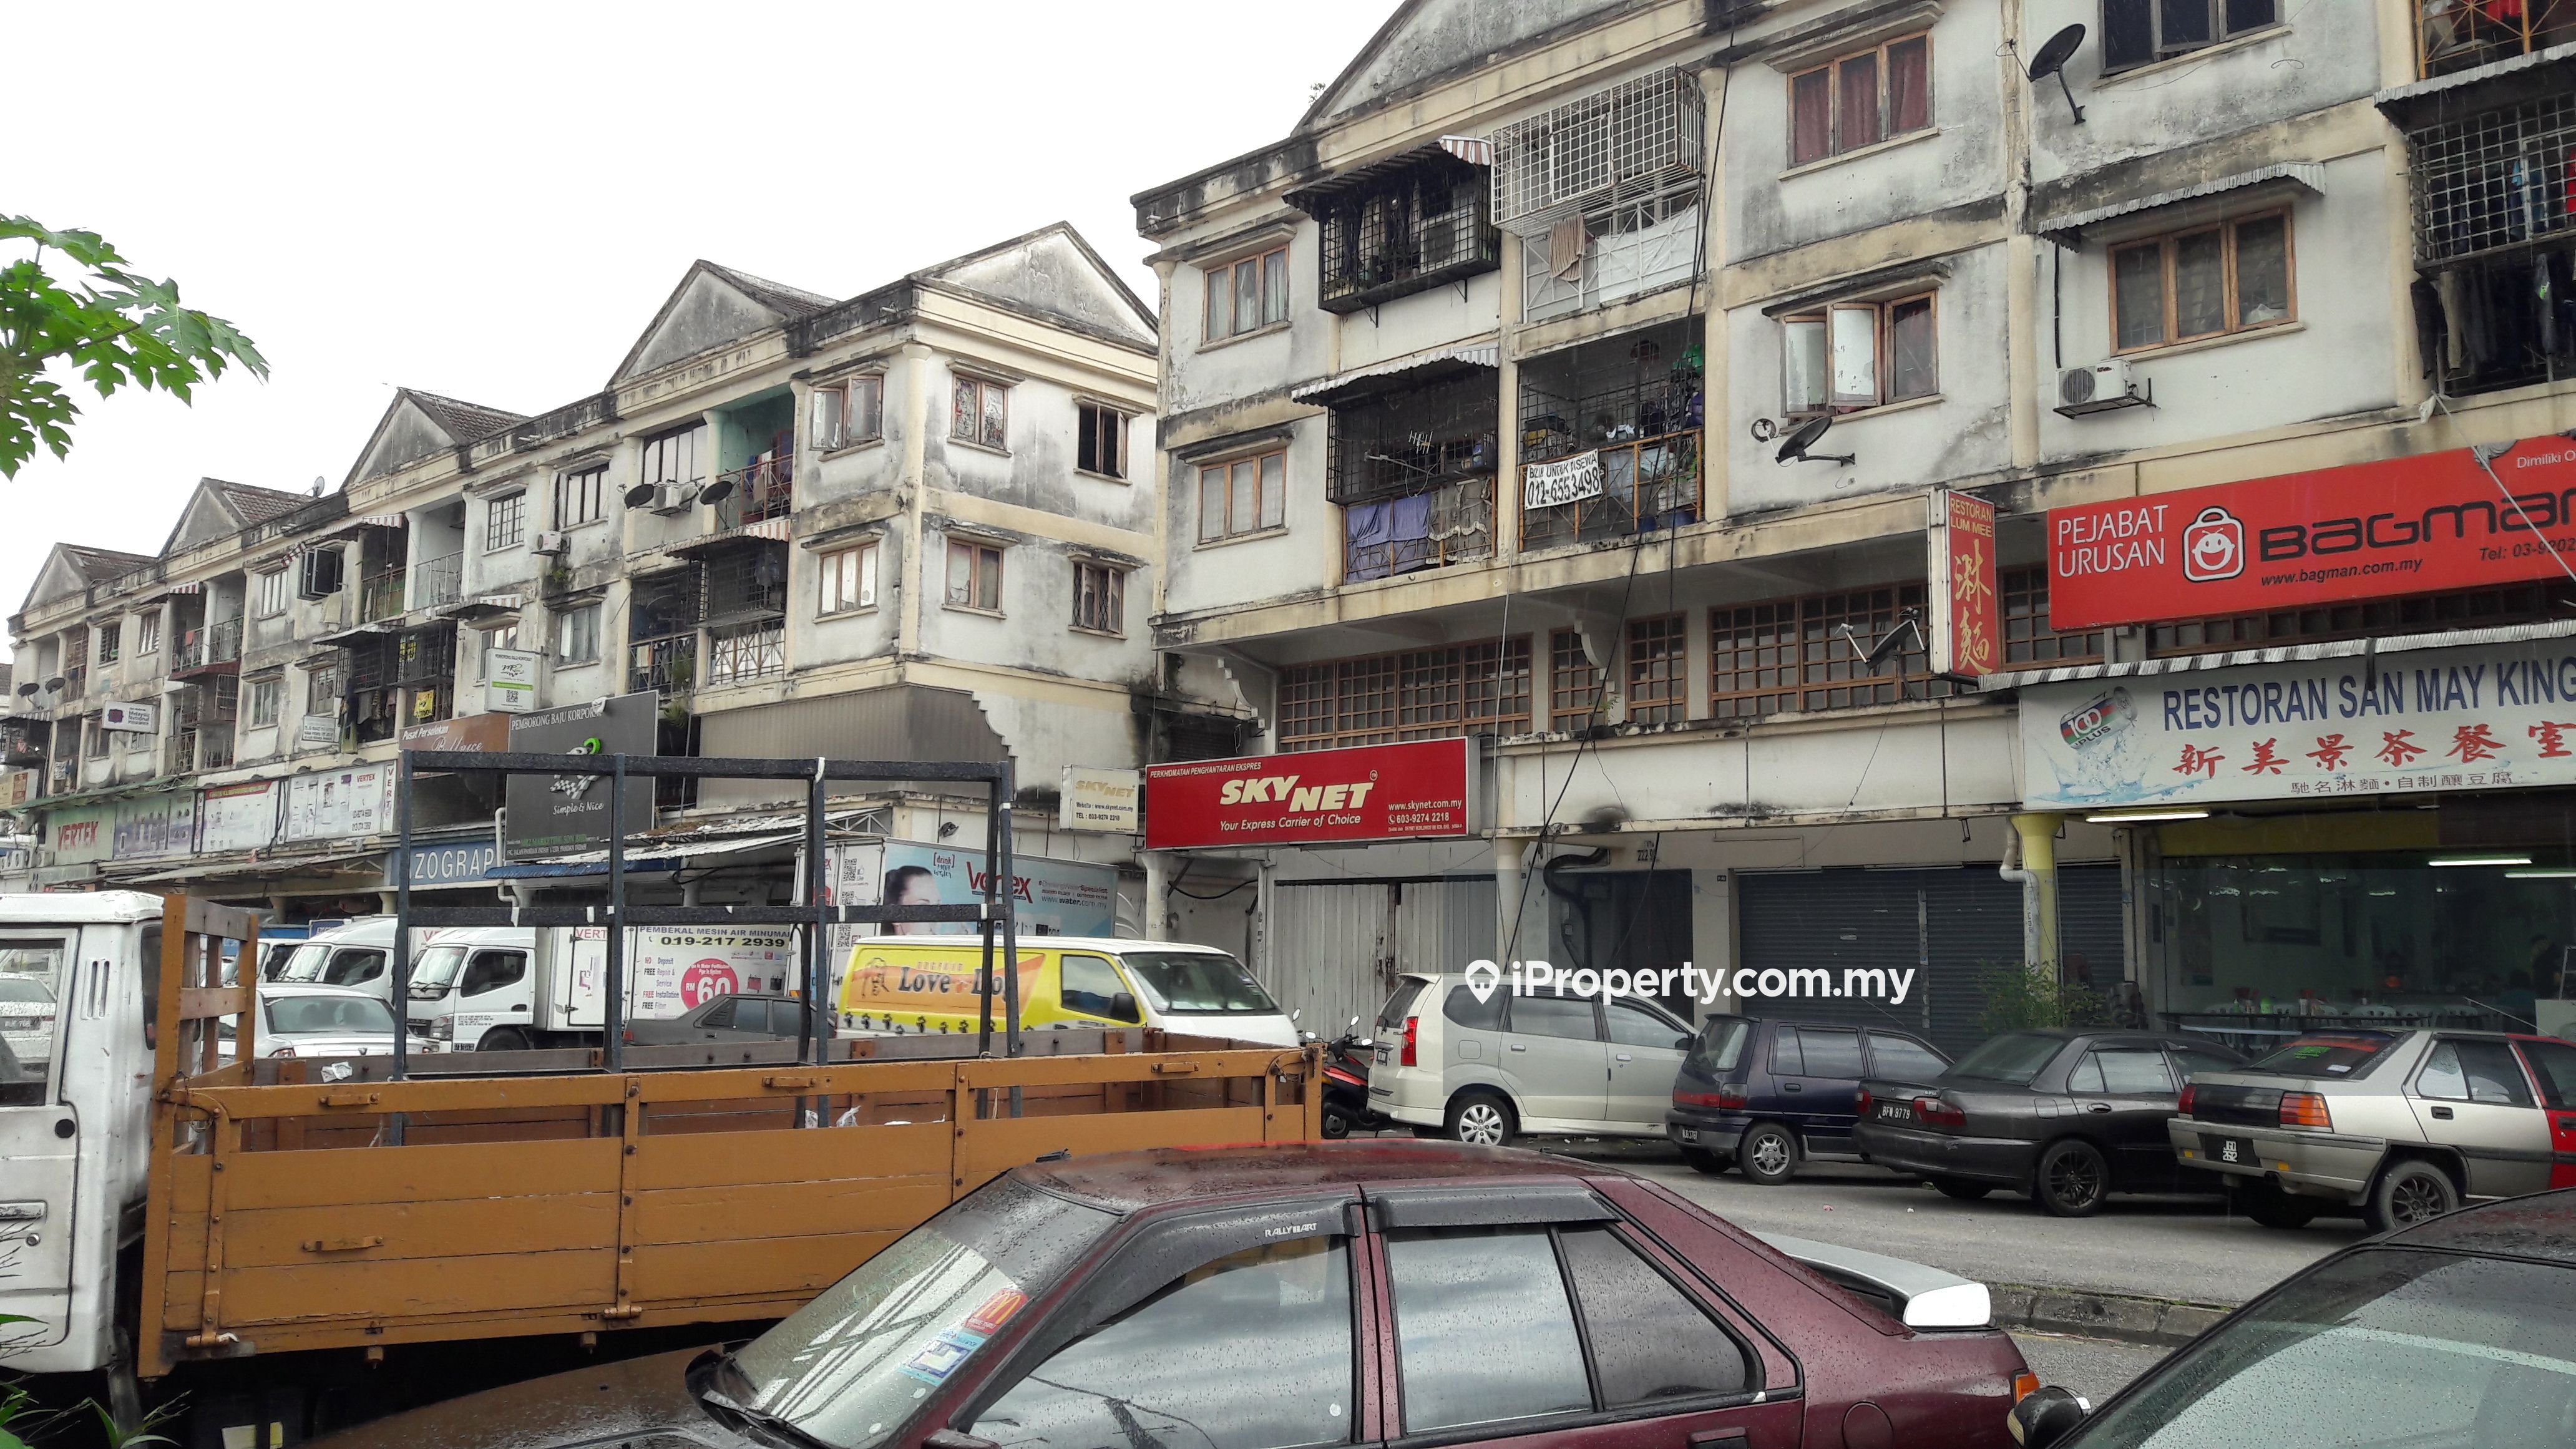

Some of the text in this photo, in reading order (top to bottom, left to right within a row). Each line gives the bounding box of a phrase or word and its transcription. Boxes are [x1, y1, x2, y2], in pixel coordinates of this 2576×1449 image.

[1546, 462, 1569, 477] UNTUK
[2517, 451, 2562, 469] Dimiliki
[1527, 466, 1599, 506] 012-6553498
[1949, 497, 1993, 523] RESTORAN
[1950, 515, 1993, 538] LUM MEE
[2057, 504, 2169, 547] PEJABAT
[2058, 537, 2165, 578] URUSAN
[2479, 546, 2507, 560] Tel:
[2261, 558, 2423, 587] www.bagman.com.my
[2164, 656, 2576, 731] RESTORAN SAN MAY KING
[510, 716, 550, 731] PEMBORONG
[550, 711, 567, 725] BAJU
[2067, 708, 2102, 739] 100
[2078, 726, 2112, 746] PLUS
[2172, 720, 2576, 779] 新美景茶餐室
[1149, 761, 1262, 778] PERKHIDMATAN PENGHANTARAN EKSPRES
[1075, 780, 1134, 798] SKYNET
[1219, 774, 1374, 812] SKYNET
[553, 803, 577, 816] Simple
[586, 801, 605, 811] Nice
[1388, 799, 1462, 811] www.skynet.com.my
[1221, 812, 1362, 832] Your Express Carrier of Choice
[1397, 812, 1450, 824] 603-9274 2218
[409, 847, 495, 880] ZOGRAP
[640, 926, 694, 935] PEMBEKAL
[660, 937, 785, 947] 019-217 2939
[685, 982, 696, 992] RM
[696, 976, 731, 1003] 60
[898, 967, 951, 994] Love
